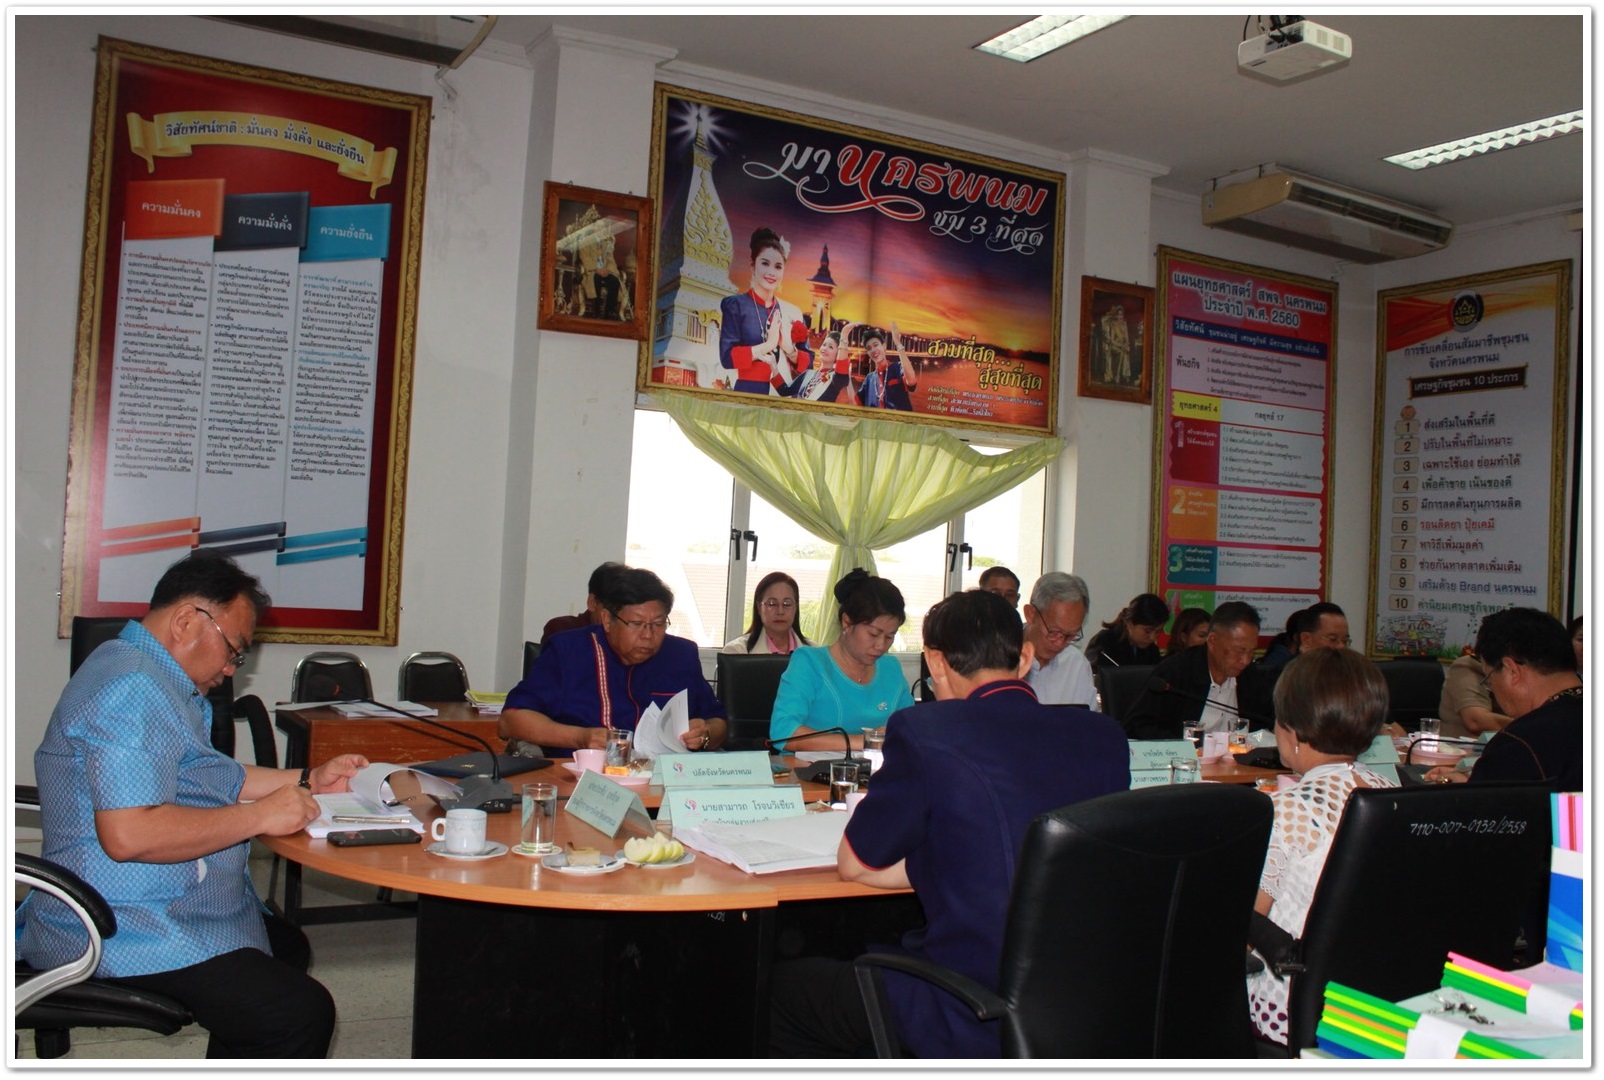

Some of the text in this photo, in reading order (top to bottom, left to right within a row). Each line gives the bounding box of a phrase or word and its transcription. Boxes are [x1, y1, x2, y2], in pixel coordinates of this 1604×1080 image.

[165, 121, 236, 136] วิสัยทัศน์ชาติ
[246, 118, 278, 138] มั่นคง
[283, 124, 312, 145] มั่งคั่ง
[316, 138, 365, 164] และยั่งยืน
[743, 142, 1048, 221] มา นครพนม
[141, 200, 200, 218] ความมั่นคง
[237, 213, 292, 230] ความมั่งคั่ง
[929, 204, 1048, 255] ชม 3 ที่สุด
[320, 224, 373, 241] ความยั่งยืน
[1174, 273, 1325, 312] แผนยุทธศาสตร์ สพจ. นครพนม
[1205, 295, 1298, 325] ประจำปี พ.ศ. 2560
[1175, 318, 1204, 334] วิสัยทัศน์
[1404, 331, 1529, 356] การขับเคลื่อนสัมมาชีพชุมชน
[1176, 354, 1200, 369] พันธกิจ
[1429, 350, 1499, 368] จังหวัดนครพนม
[978, 363, 1043, 394] สู่สุขที่สุด
[1474, 375, 1484, 385] 10
[1487, 371, 1518, 384] ประการ
[1276, 413, 1284, 421] 17
[1404, 422, 1410, 432] 1
[1404, 444, 1410, 452] 2
[1403, 460, 1410, 471] 3
[1402, 480, 1409, 491] 4
[1172, 487, 1185, 514] 2
[1402, 500, 1409, 511] 5
[1401, 519, 1408, 531] 6
[1400, 539, 1407, 549] 7
[1168, 545, 1183, 573] 3
[1399, 558, 1407, 569] 8
[1398, 576, 1406, 588] 9
[1459, 582, 1490, 591] Brand
[1494, 584, 1536, 594] นครพนม
[1395, 597, 1408, 609] 10
[702, 803, 748, 812] นายสามารถ
